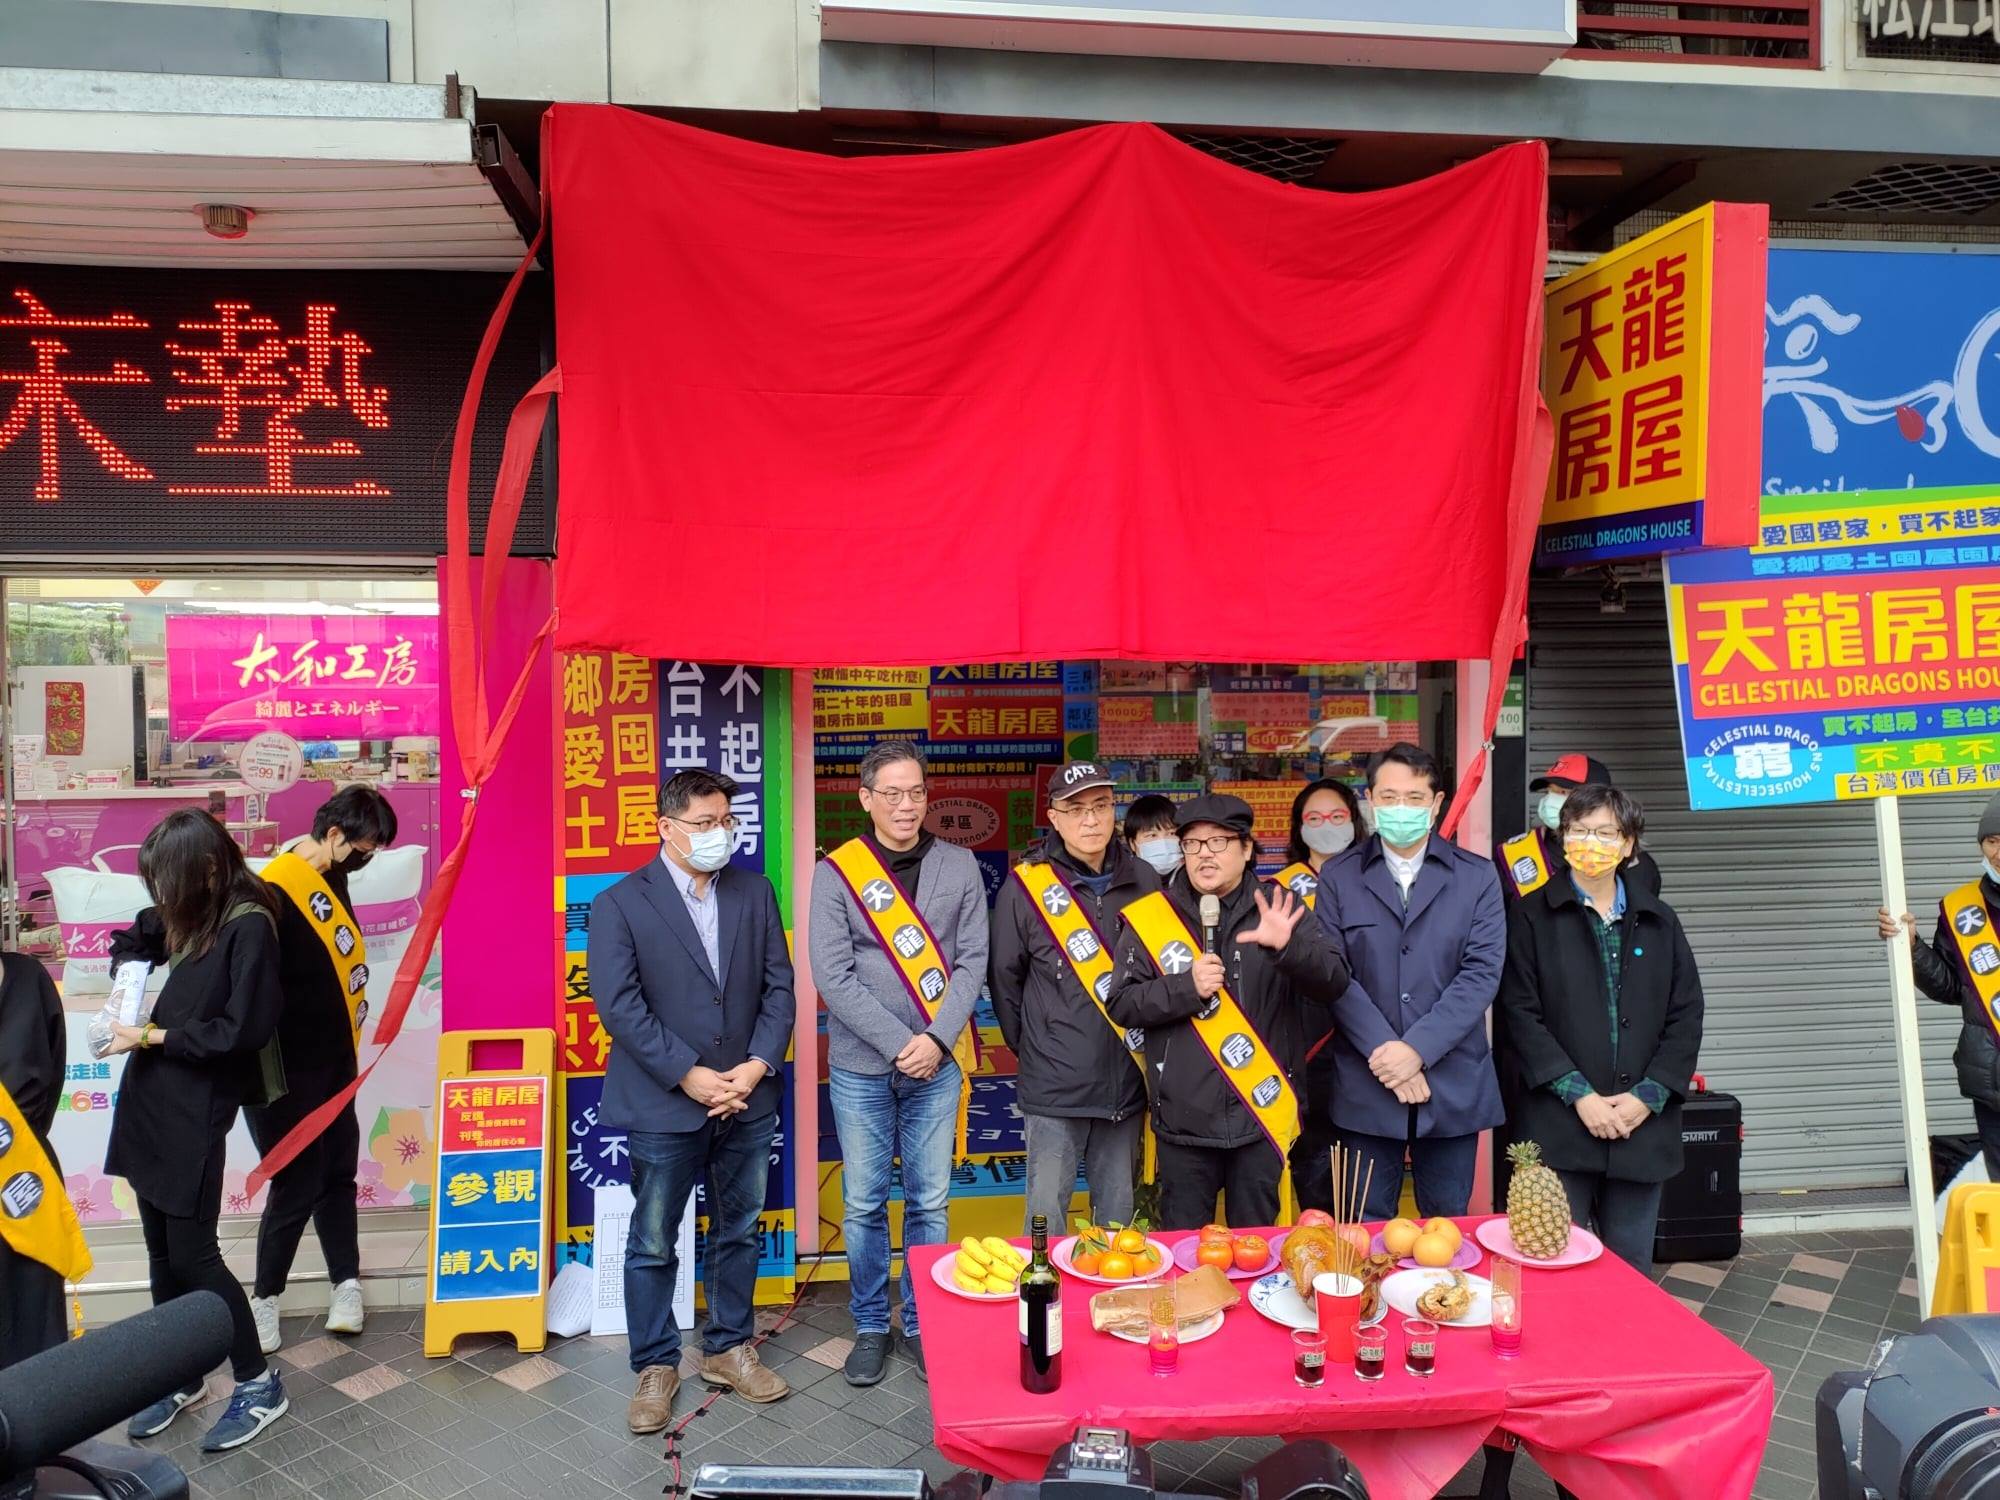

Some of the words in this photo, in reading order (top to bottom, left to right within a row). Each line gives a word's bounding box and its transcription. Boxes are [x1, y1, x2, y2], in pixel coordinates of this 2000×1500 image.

[1560, 253, 1687, 394] 天龍
[0, 290, 391, 499] 床墊
[1556, 374, 1684, 501] 房屋
[1545, 533, 1594, 553] CELESTIAL
[1596, 524, 1648, 549] DRAGONS
[1650, 517, 1692, 541] HOUSE
[1696, 584, 2000, 677] 天龍房屋
[1700, 677, 1831, 707] CELESTIAL
[1837, 669, 1952, 698] DRAGONS
[255, 699, 401, 719] 綺麗とエネルギー
[936, 706, 1058, 736] 天龍房屋
[1703, 723, 1770, 758] CELESTIAL
[940, 815, 973, 830] 學區
[447, 1085, 540, 1109] 天龍房屋
[446, 1169, 536, 1206] 參觀
[440, 1245, 538, 1276] 請入內
